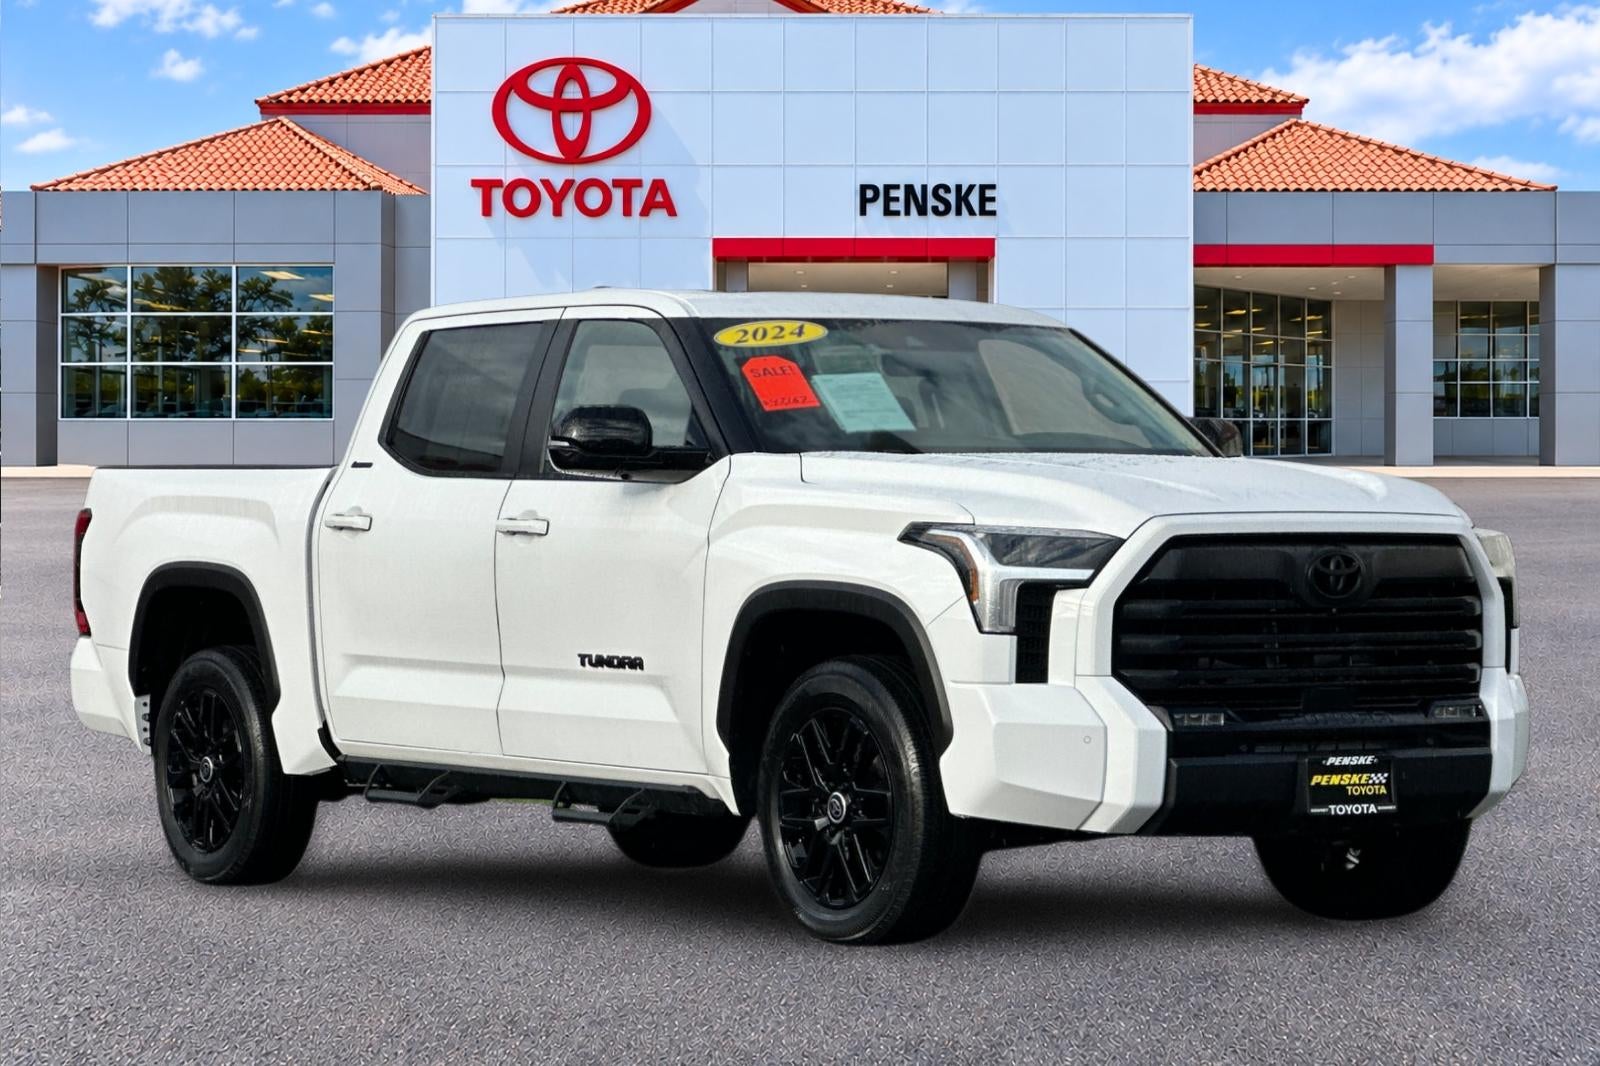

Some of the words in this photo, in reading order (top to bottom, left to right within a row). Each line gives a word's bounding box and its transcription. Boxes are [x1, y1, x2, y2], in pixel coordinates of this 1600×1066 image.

[471, 179, 677, 218] TOYOTA
[858, 183, 997, 217] PENSKE
[734, 323, 805, 344] 2024
[577, 653, 644, 671] TUNDRA
[1326, 755, 1375, 766] PENSKE
[1310, 773, 1371, 785] PENSKE
[1346, 785, 1387, 796] TOYOTA
[1328, 803, 1378, 815] TOYOTA
